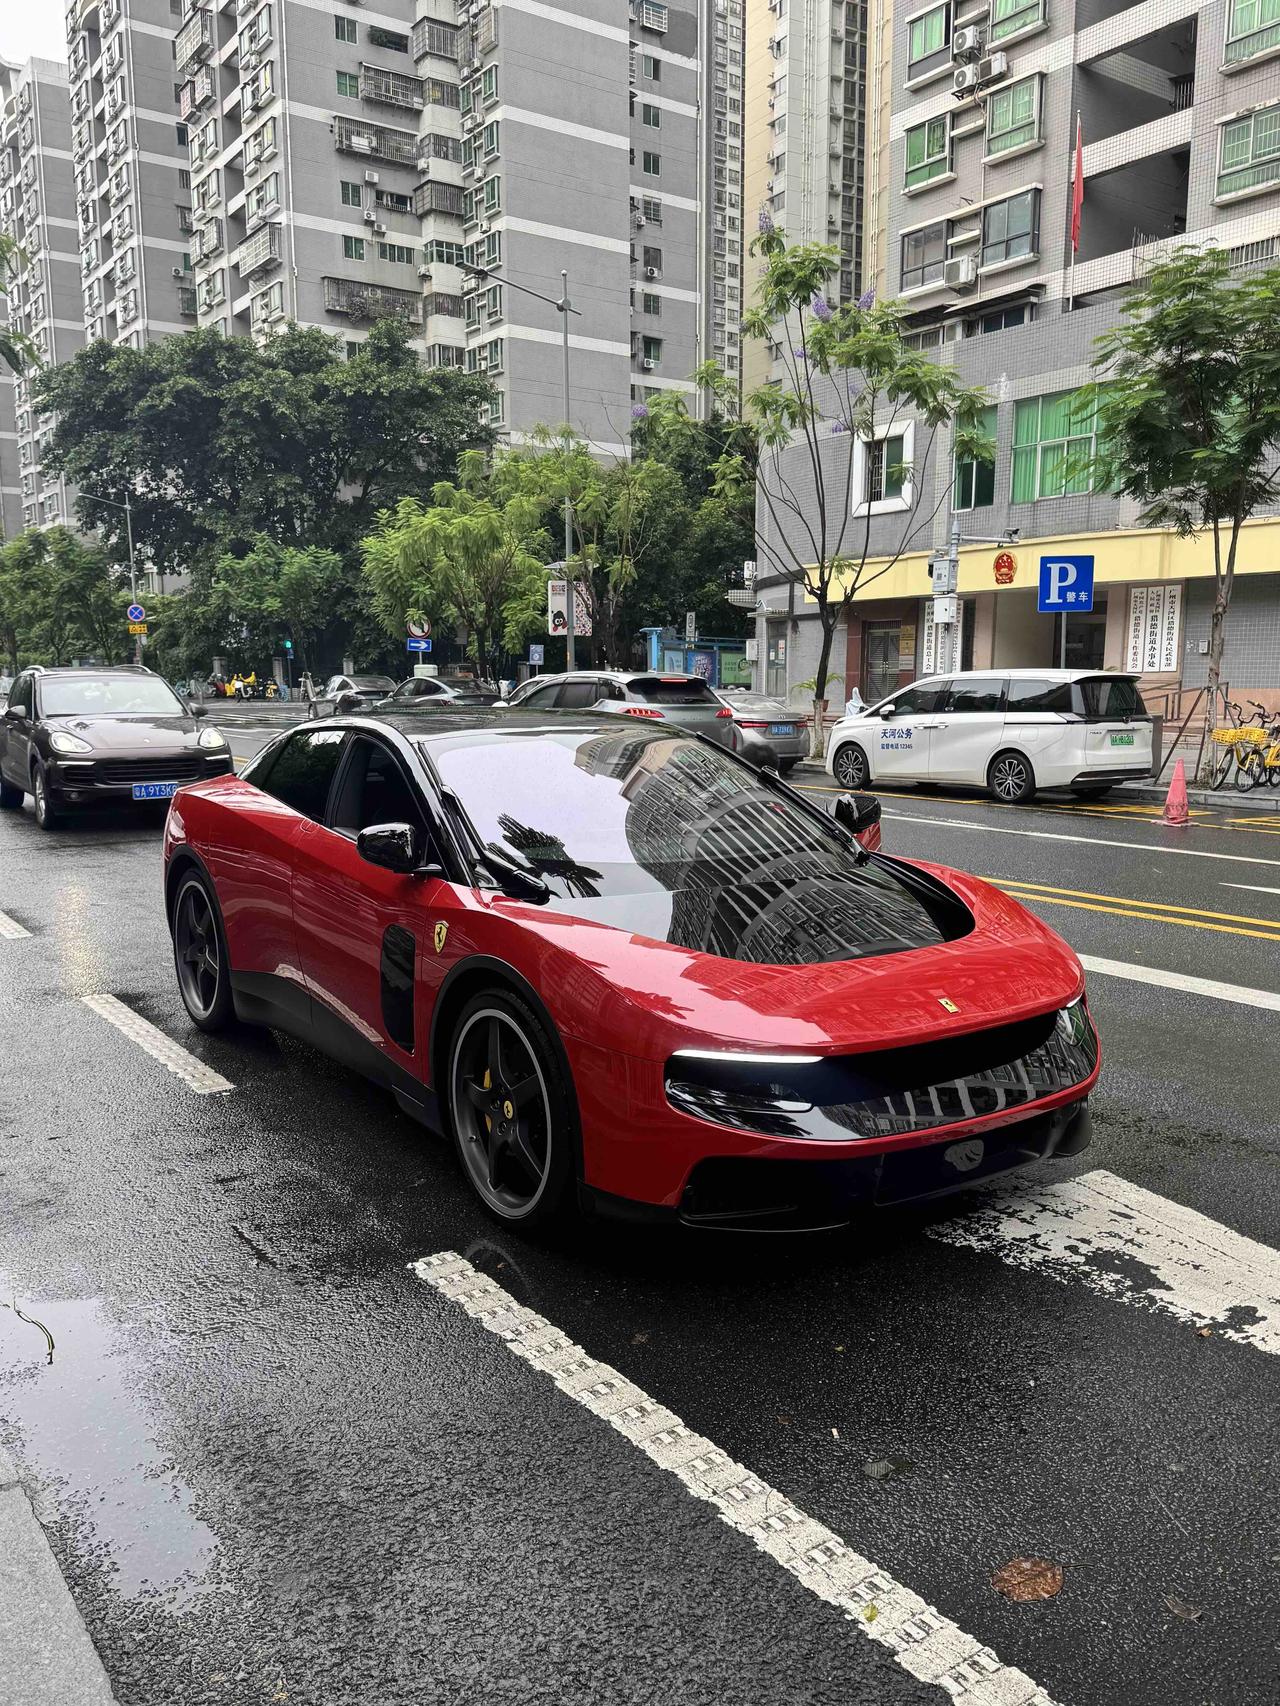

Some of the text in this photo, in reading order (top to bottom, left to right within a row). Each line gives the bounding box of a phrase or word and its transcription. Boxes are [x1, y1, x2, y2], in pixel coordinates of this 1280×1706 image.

[1045, 562, 1077, 603] P
[1066, 591, 1089, 603] 警车
[881, 728, 913, 739] 天河公务
